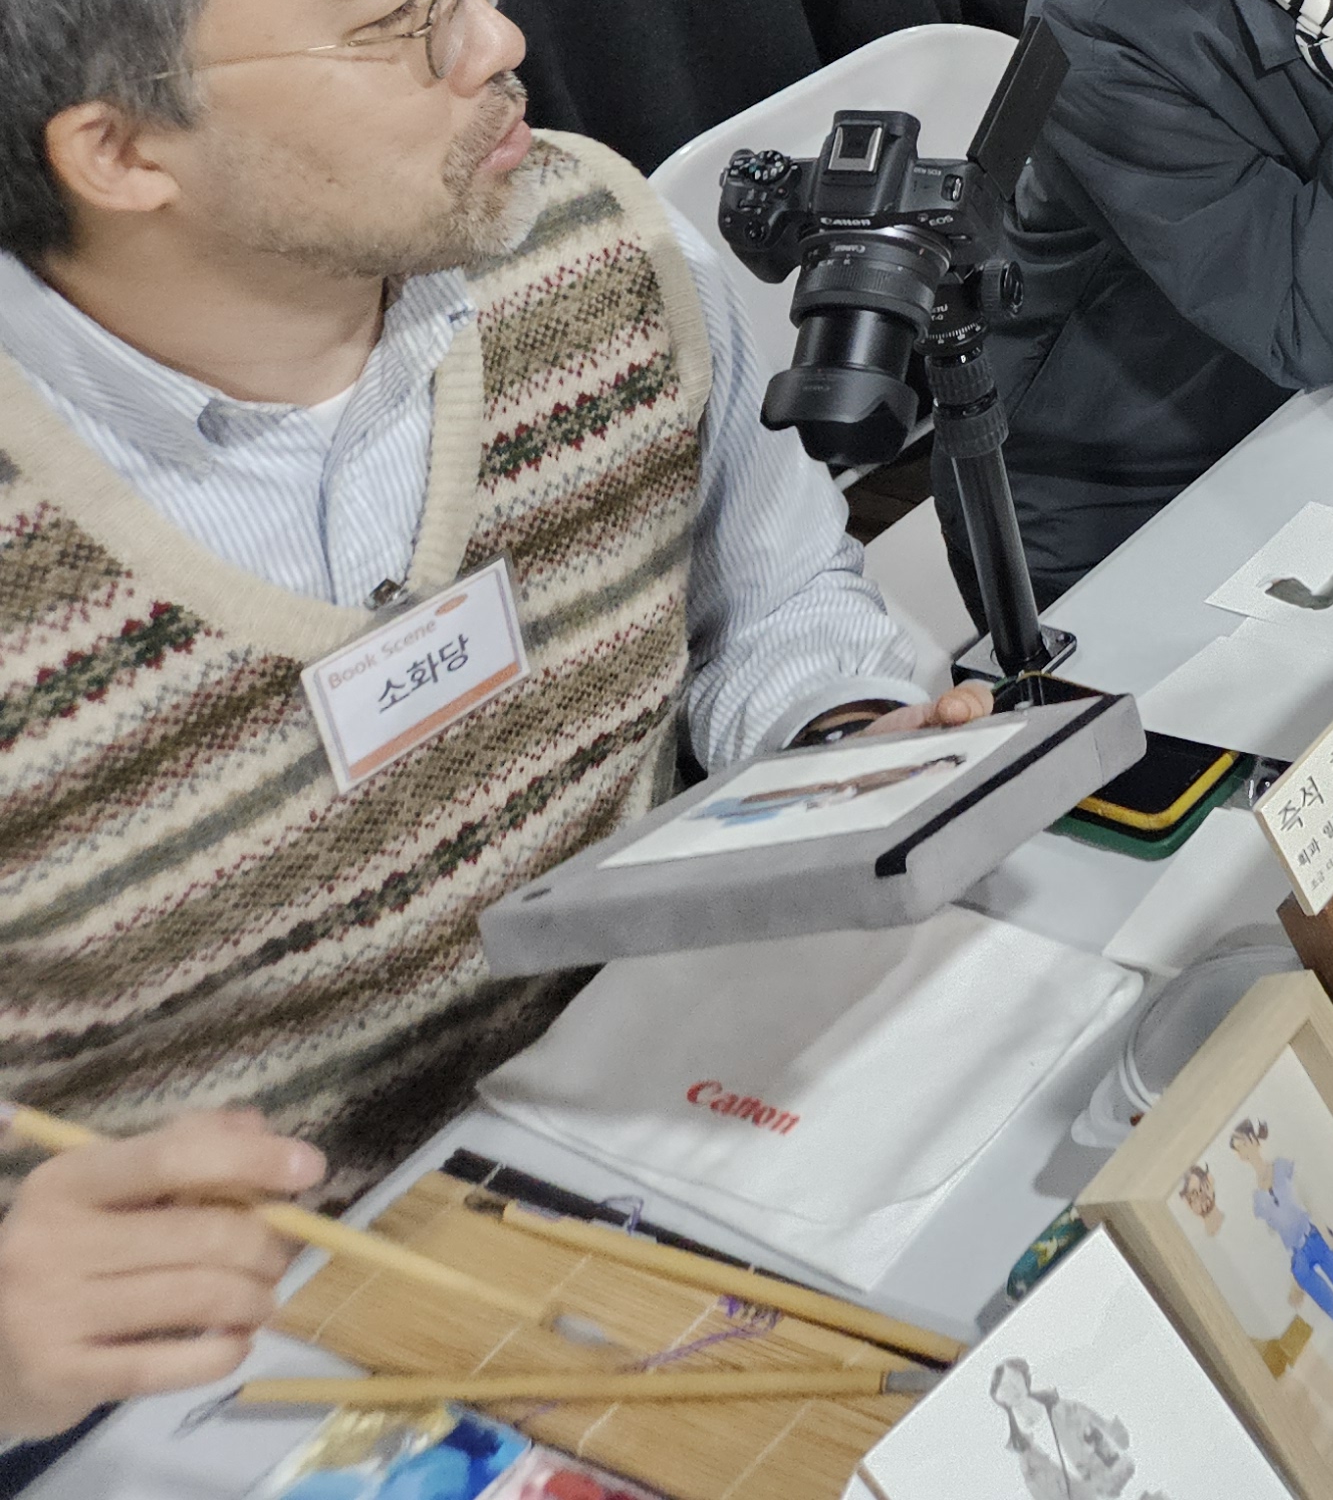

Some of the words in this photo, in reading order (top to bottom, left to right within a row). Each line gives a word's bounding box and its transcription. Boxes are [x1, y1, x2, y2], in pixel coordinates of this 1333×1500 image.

[820, 216, 871, 227] Canon
[928, 215, 954, 227] EOS
[327, 653, 377, 690] Book
[380, 619, 436, 656] Scene
[379, 634, 468, 711] 소화당
[1278, 775, 1324, 831] 즉석
[1297, 837, 1320, 866] 획과
[686, 1078, 802, 1137] Canon
